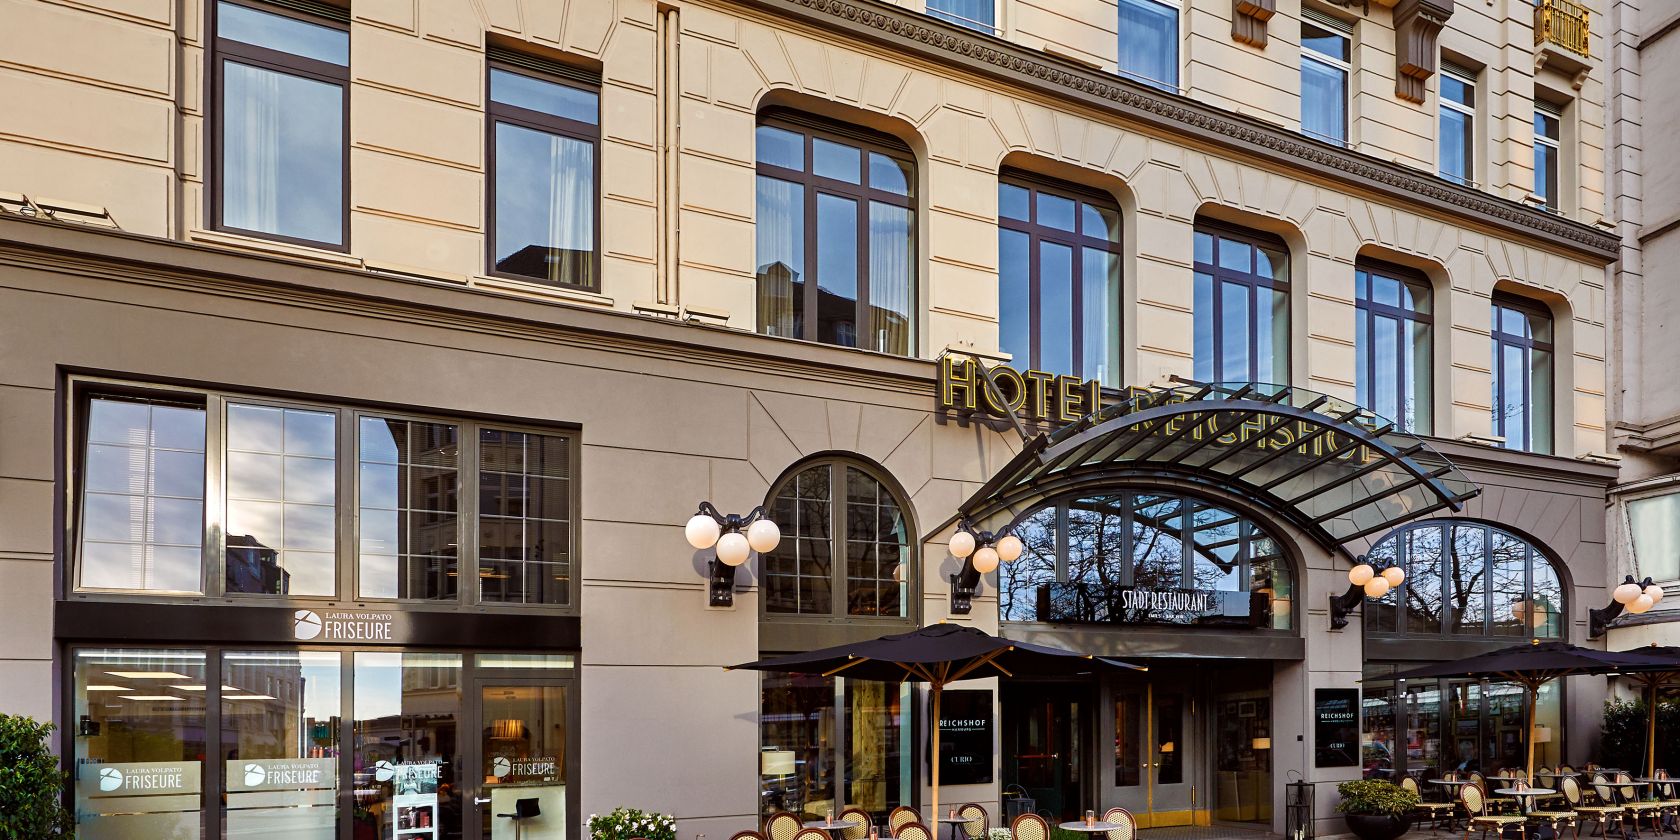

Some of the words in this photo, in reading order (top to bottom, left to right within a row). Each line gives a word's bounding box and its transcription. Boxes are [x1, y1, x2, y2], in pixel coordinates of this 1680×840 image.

[938, 355, 1105, 427] HOTEL
[1122, 590, 1149, 610] STADT
[1151, 591, 1208, 612] RESTAURANT
[325, 612, 354, 620] LAURA
[355, 613, 392, 621] VOLPATO
[325, 621, 392, 640] FRISEURE
[939, 719, 986, 727] REICHSHOF
[512, 762, 555, 776] FRISEURE
[125, 774, 182, 790] FRISEURE
[267, 770, 321, 785] FRISEURE
